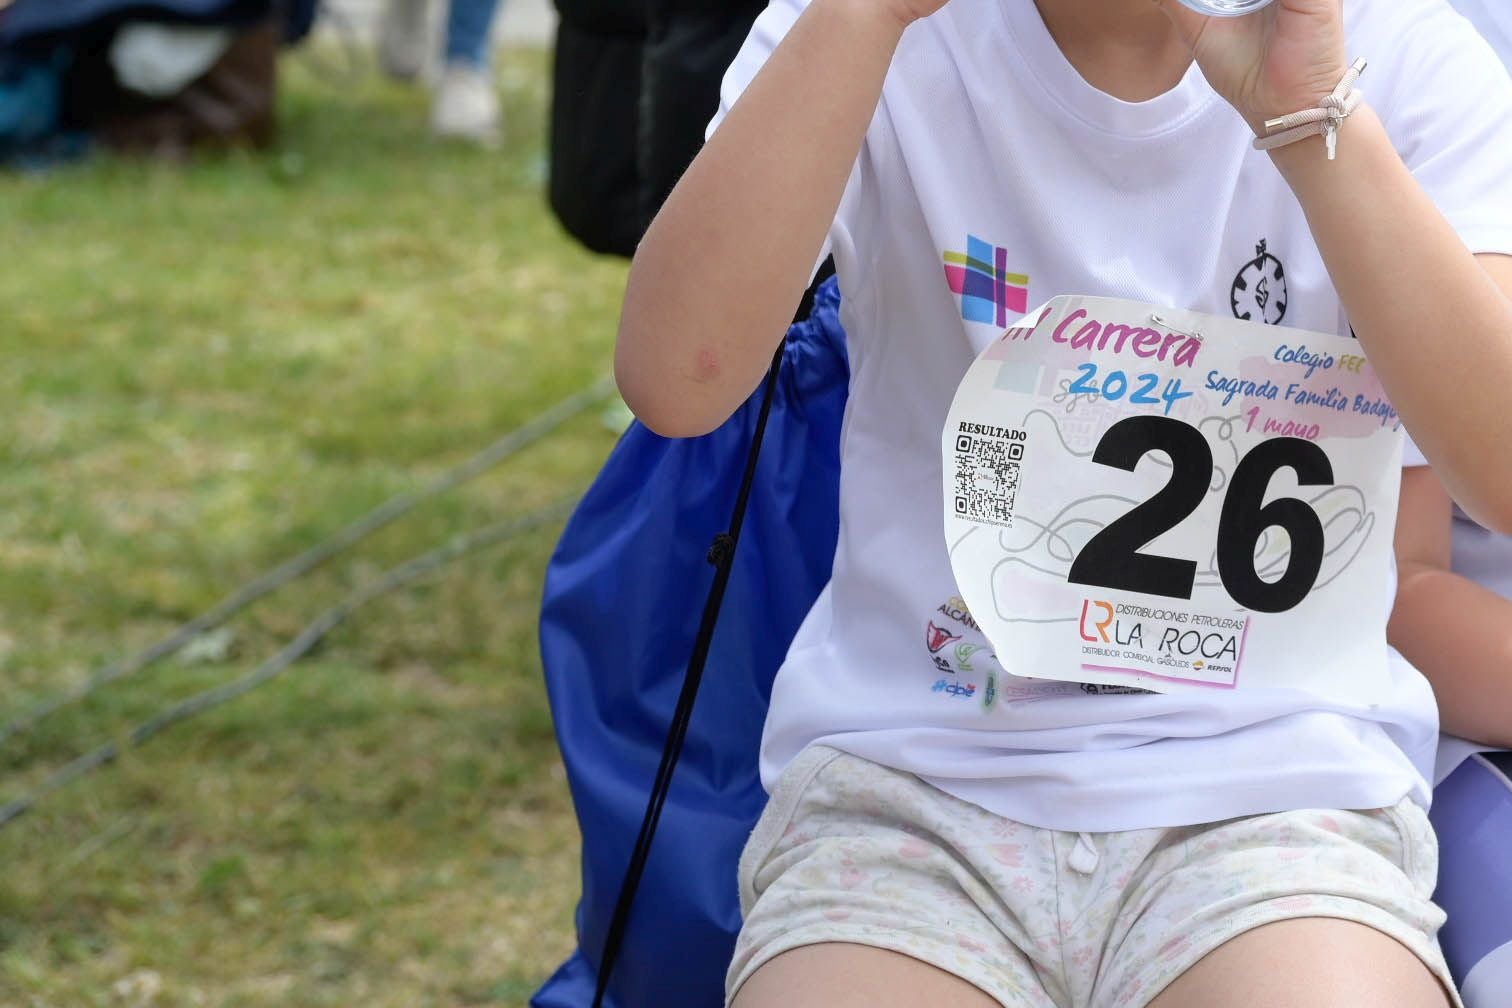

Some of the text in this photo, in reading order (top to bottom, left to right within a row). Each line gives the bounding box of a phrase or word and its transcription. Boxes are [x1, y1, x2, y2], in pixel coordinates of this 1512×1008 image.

[1052, 308, 1201, 368] Carrera
[1274, 344, 1334, 379] Colegio
[1068, 363, 1193, 416] 2024
[1205, 370, 1279, 406] Sagrada
[1285, 383, 1348, 411] Familia
[958, 422, 1027, 441] RESULTADO
[1246, 405, 1260, 432] 1
[1067, 415, 1334, 614] 26
[1115, 603, 1244, 630] DISTRIBUCIONES PETROLERAS
[1115, 620, 1236, 661] LA ROCA
[1207, 664, 1232, 673] REPSOL
